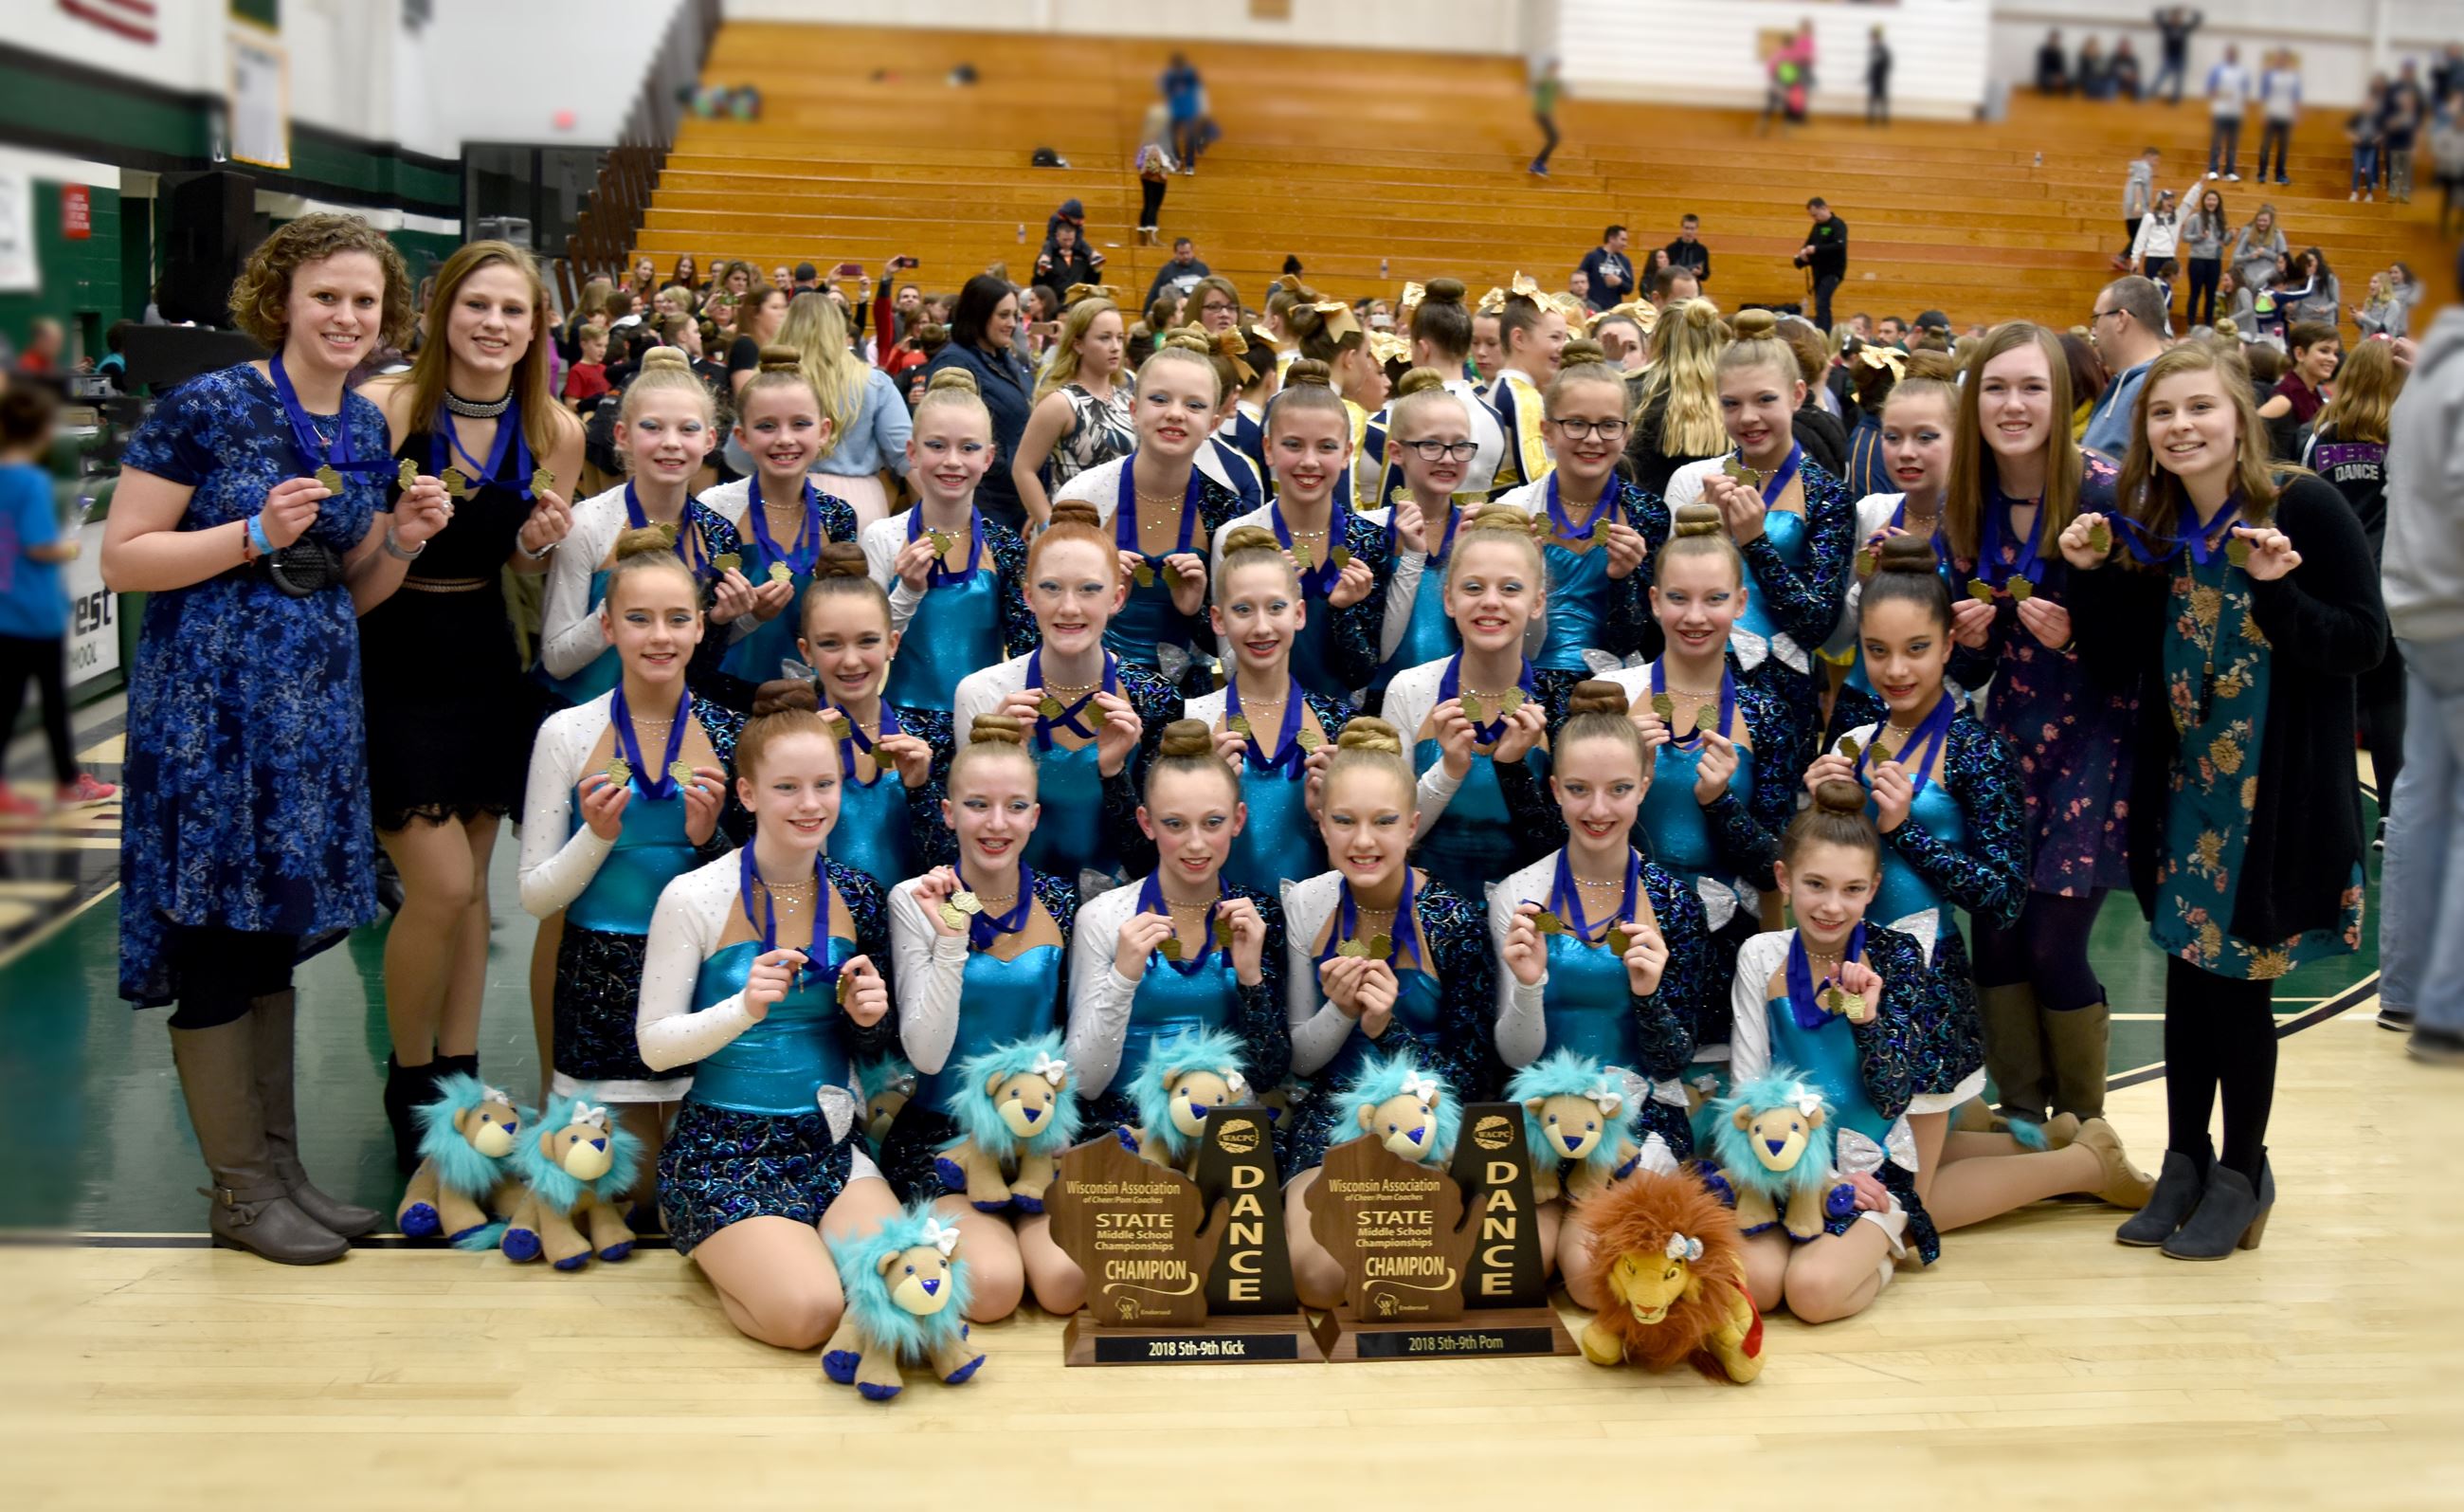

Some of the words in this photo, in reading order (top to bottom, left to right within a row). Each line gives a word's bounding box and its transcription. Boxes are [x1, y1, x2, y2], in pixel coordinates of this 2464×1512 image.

[2334, 464, 2379, 483] DANCE
[72, 586, 112, 637] est
[1221, 1134, 1256, 1142] WACPC
[1066, 1181, 1119, 1194] Wisconsin
[1120, 1181, 1181, 1195] Association
[1329, 1178, 1380, 1193] Wisconsin
[1382, 1178, 1440, 1193] Association
[1096, 1213, 1174, 1228] STATE
[1357, 1211, 1434, 1225] STATE
[1096, 1230, 1135, 1239] Middle
[1136, 1230, 1173, 1239] School
[1228, 1165, 1265, 1302] DANCE
[1358, 1228, 1395, 1236] Middle
[1396, 1227, 1432, 1236] School
[1481, 1161, 1519, 1295] DANCE
[1095, 1242, 1174, 1252] Championships
[1355, 1238, 1433, 1249] Championships
[1105, 1260, 1187, 1280] CHAMPION
[1365, 1256, 1444, 1276] CHAMPION
[1149, 1341, 1177, 1357] 2018
[1178, 1339, 1220, 1356] 5th-9th
[1221, 1339, 1245, 1355] Kick
[1408, 1337, 1436, 1351] 2018
[1437, 1335, 1477, 1350] 5th-9th
[1478, 1335, 1504, 1349] Pom
